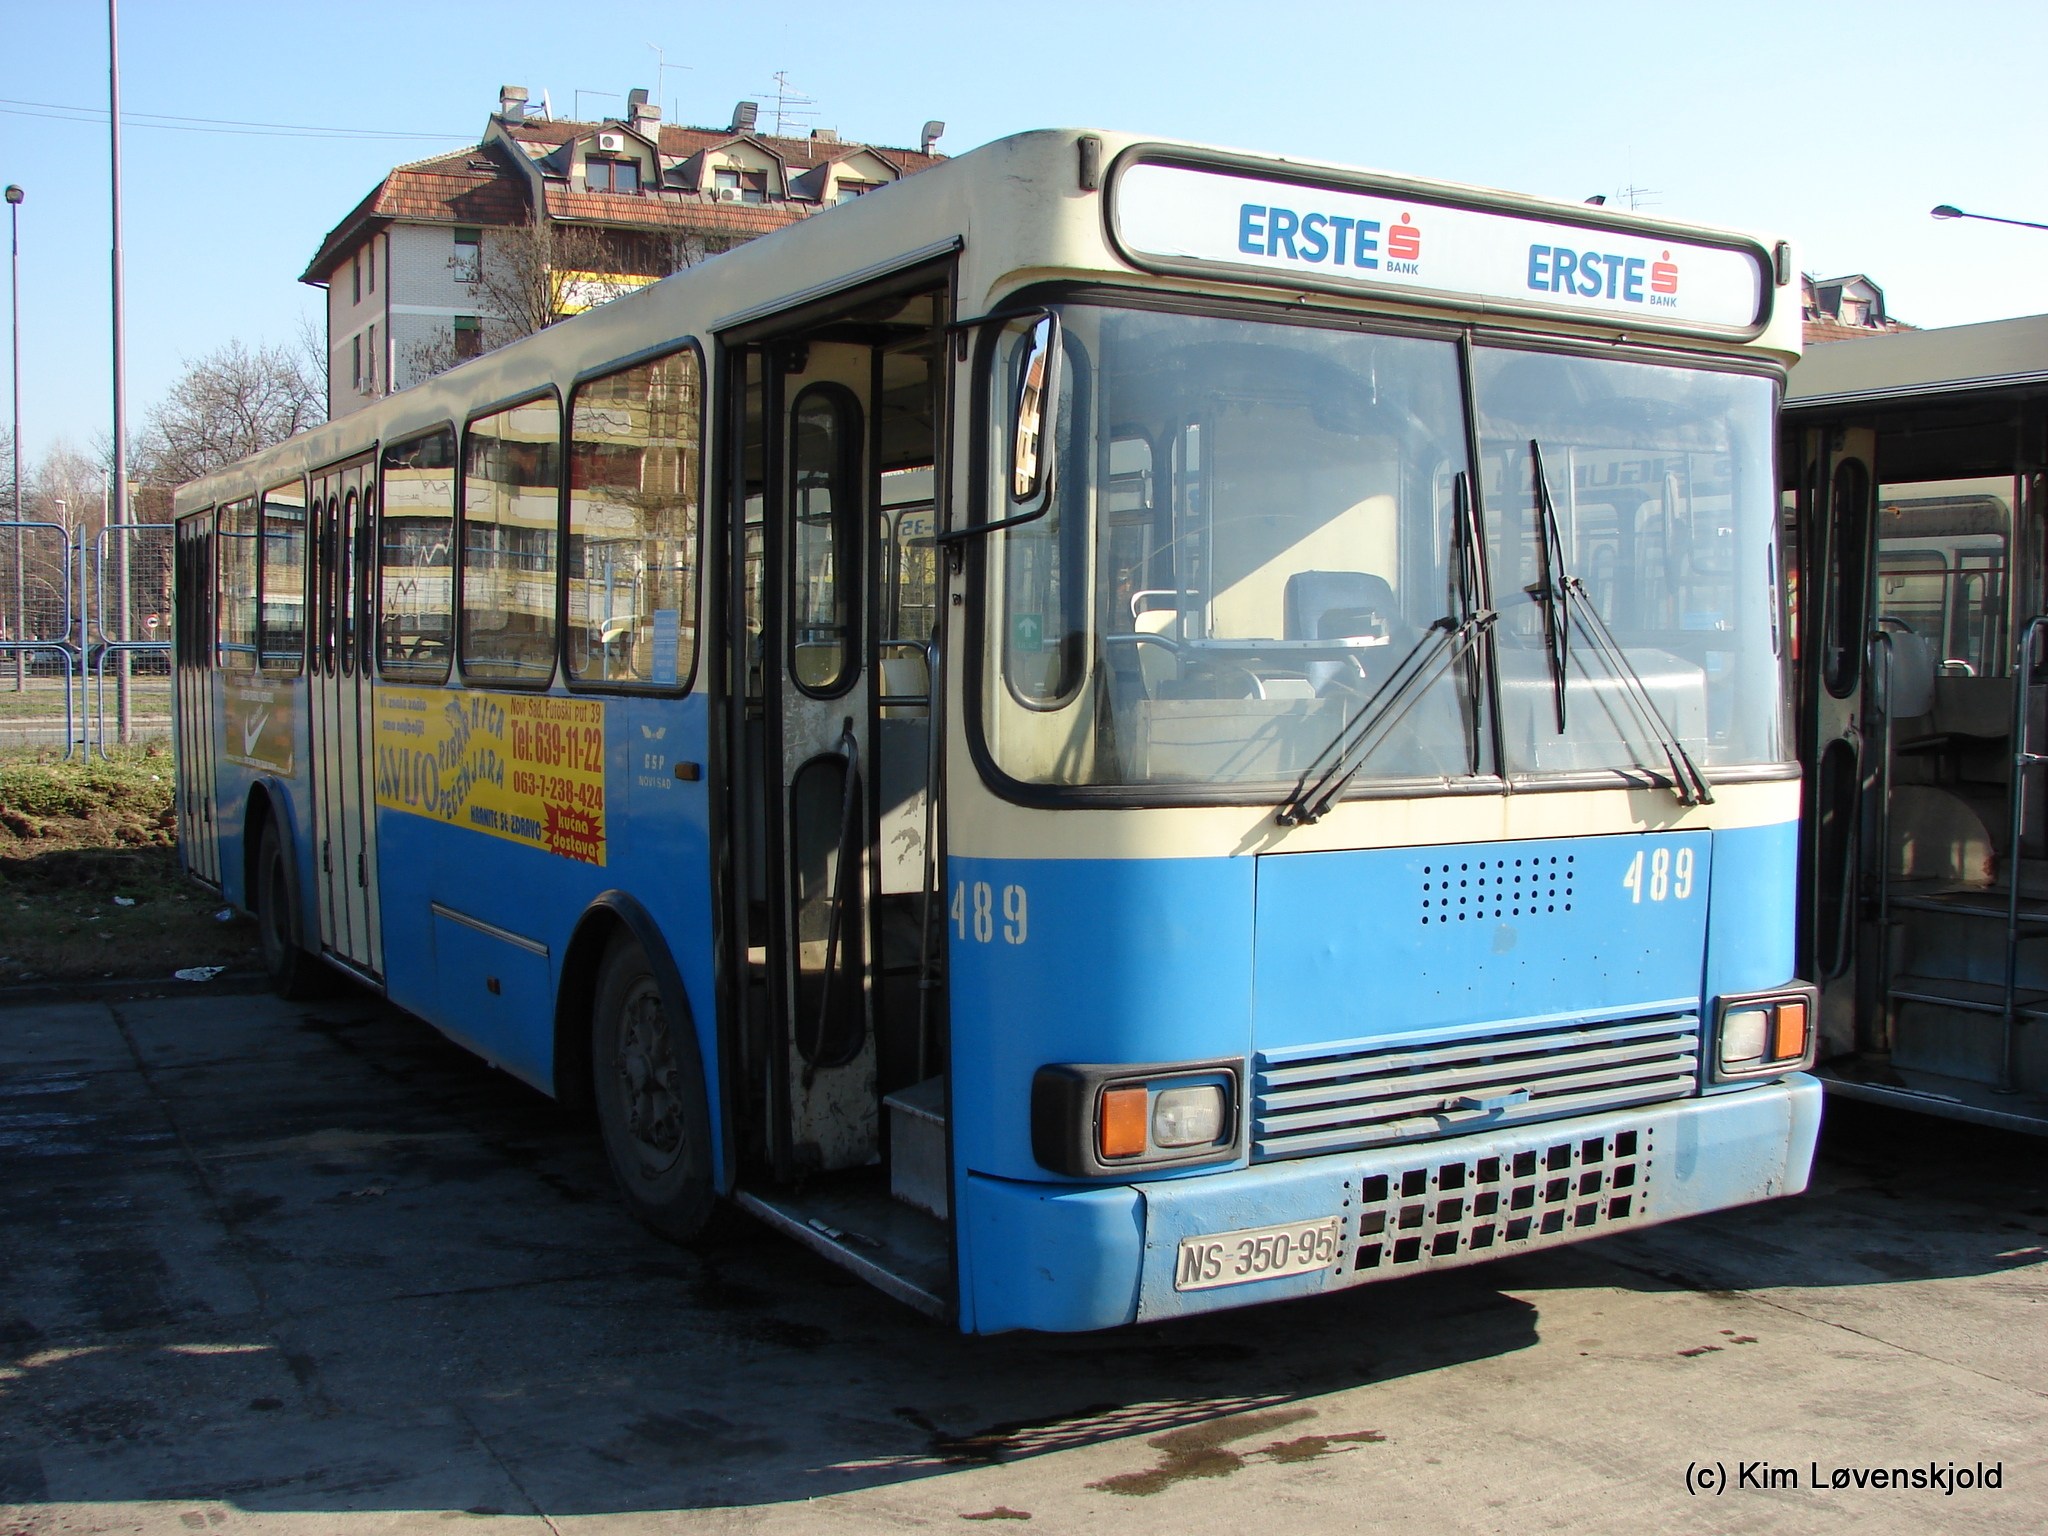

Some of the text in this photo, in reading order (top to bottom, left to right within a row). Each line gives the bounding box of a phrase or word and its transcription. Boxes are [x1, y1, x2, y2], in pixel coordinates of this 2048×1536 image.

[1238, 203, 1381, 270] ERSTE
[1386, 261, 1419, 276] BANK
[1527, 243, 1646, 304] ERSTE
[1649, 295, 1677, 308] BANK
[510, 697, 601, 724] Novi Sad, Futoški put 39
[438, 697, 504, 772] RIBARNICA
[511, 719, 602, 773] Tel: 639-11-22
[377, 743, 439, 812] AVISO
[513, 770, 604, 811] 063-7-238-424
[657, 777, 671, 790] SAD
[470, 805, 542, 841] HRANITE SE ZDRAVO
[557, 810, 589, 835] kućna
[553, 830, 596, 857] dostava
[1623, 847, 1694, 904] 489
[951, 880, 1028, 945] 489
